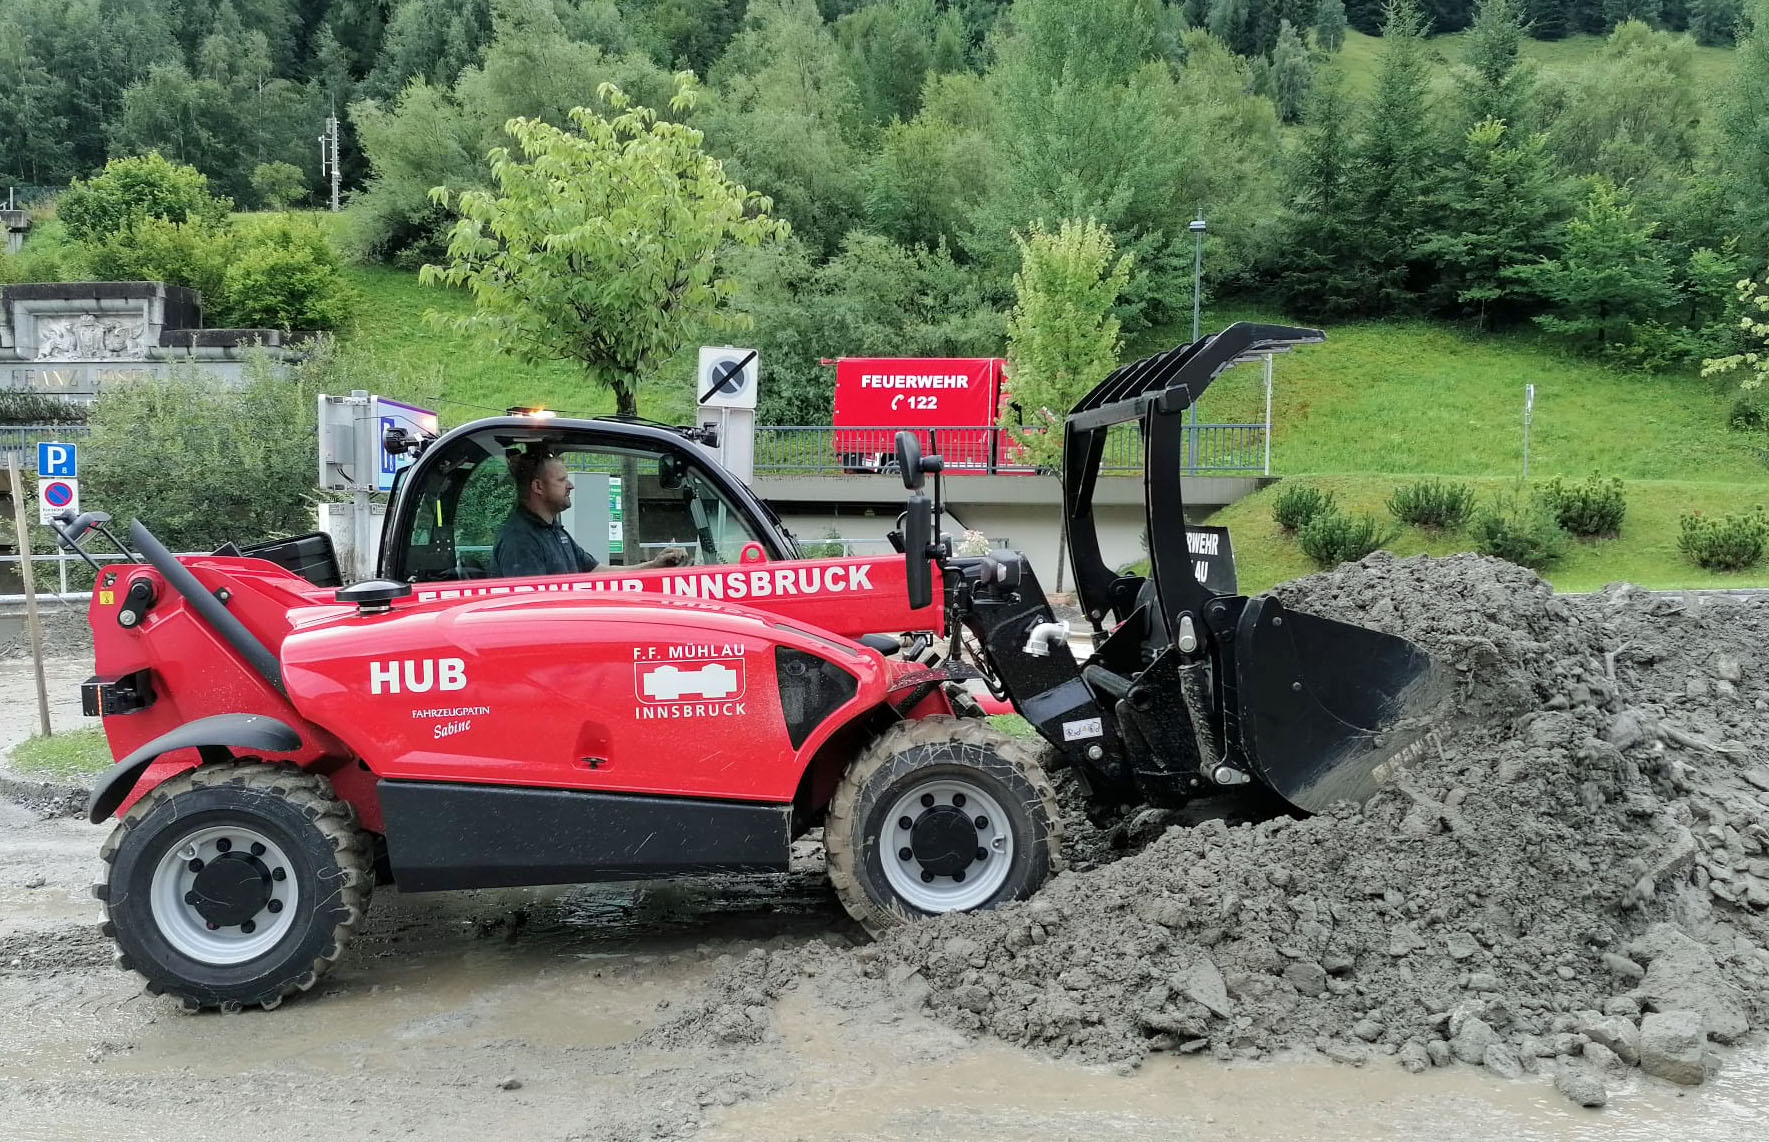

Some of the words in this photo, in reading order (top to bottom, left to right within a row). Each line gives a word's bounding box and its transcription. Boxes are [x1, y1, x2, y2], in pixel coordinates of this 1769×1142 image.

[861, 375, 969, 389] FEUERWEHR
[907, 396, 938, 410] 122
[47, 446, 67, 474] P
[1185, 532, 1219, 555] RWEHR
[661, 564, 874, 600] INNSBRUCK
[633, 647, 662, 660] F.F.
[668, 642, 746, 659] MÜHLAU
[369, 657, 468, 695] HUB
[411, 706, 491, 719] FAHRZEUGPATIN
[635, 702, 747, 719] INNSBRUCK
[433, 719, 472, 740] Sabine
